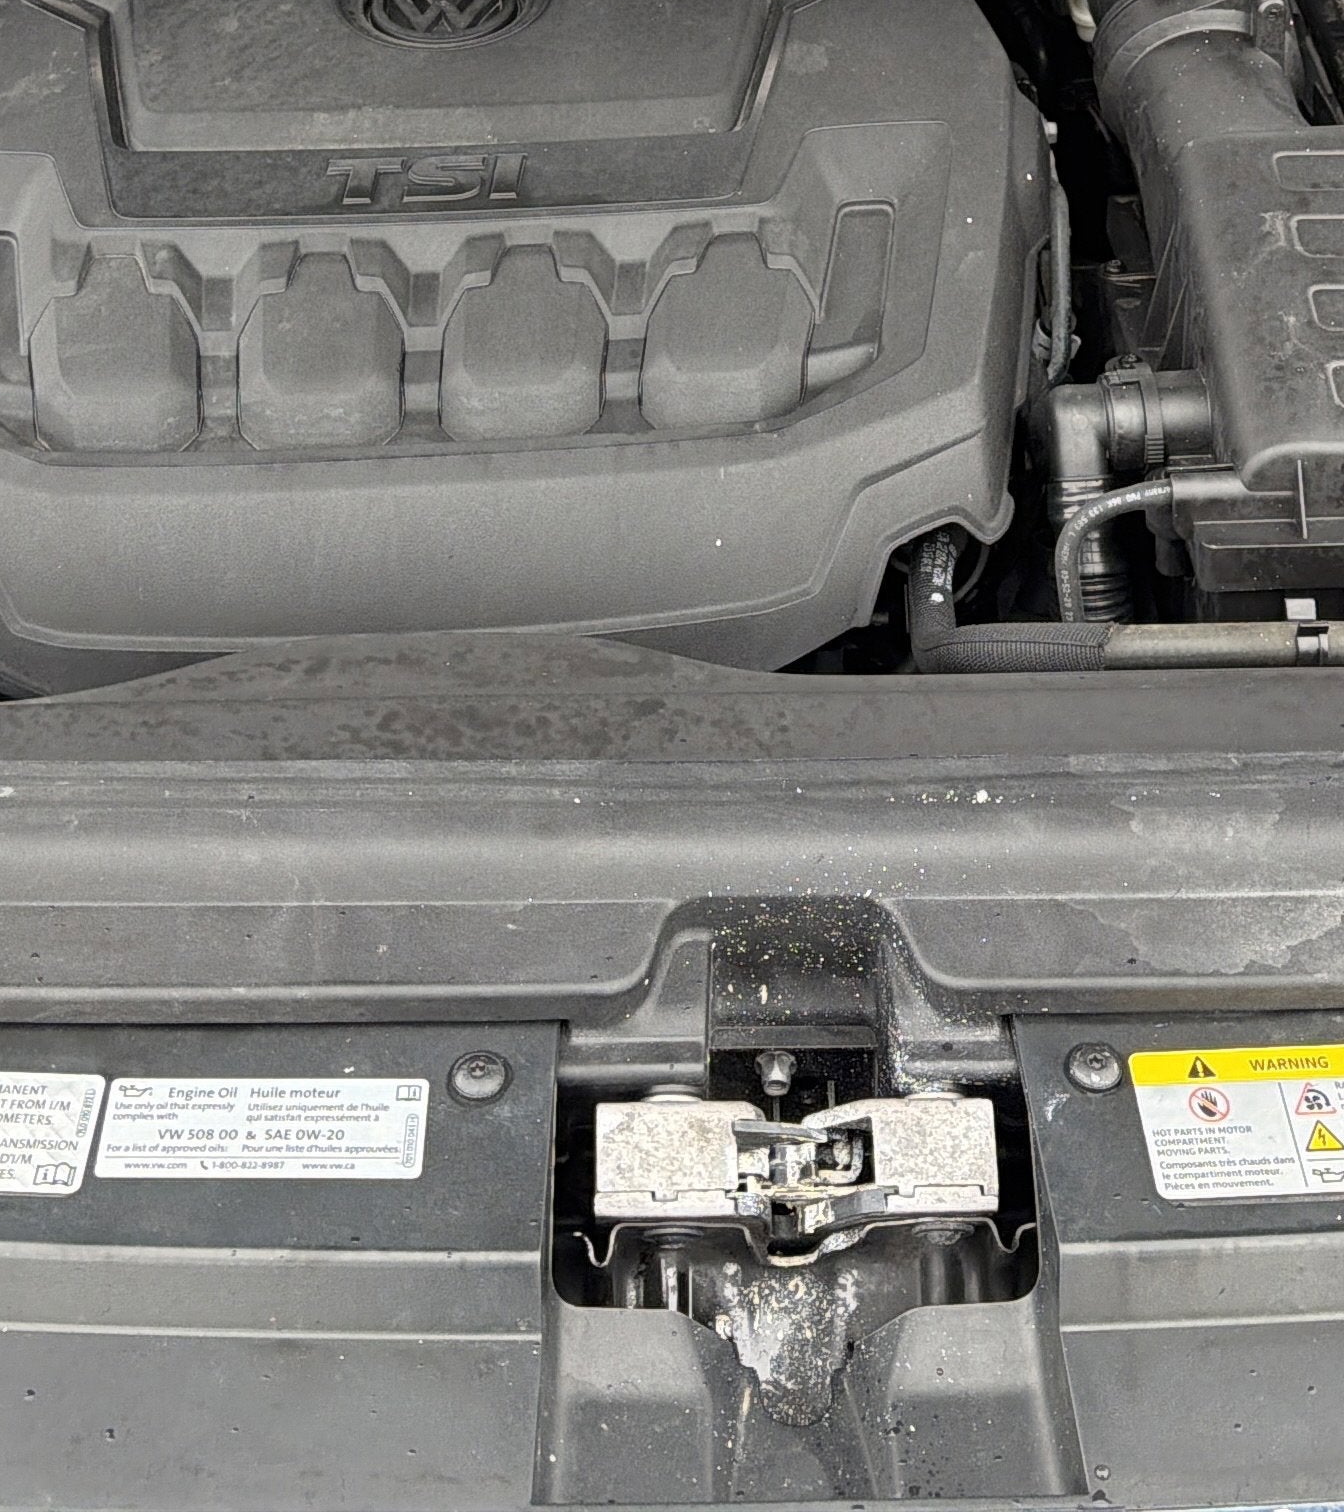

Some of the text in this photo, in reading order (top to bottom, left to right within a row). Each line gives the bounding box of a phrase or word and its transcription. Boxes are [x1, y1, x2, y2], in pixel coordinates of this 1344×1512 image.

[325, 152, 529, 205] TSI
[1249, 1056, 1329, 1072] WARNING
[167, 1087, 238, 1101] Engine Oil
[249, 1087, 340, 1098] Huile moteur
[8, 1099, 46, 1109] FROM
[48, 1100, 71, 1111] I/M
[114, 1102, 235, 1112] Use only oil that expressly
[247, 1103, 390, 1113] Utilisez uniquement de l'huile
[112, 1113, 154, 1122] complies
[245, 1113, 379, 1123] qui satisfait expressément à
[157, 1129, 345, 1140] VW 508 00 & SAE 0W-20
[1151, 1125, 1252, 1137] HOT PARTS IN MOTOR
[106, 1143, 122, 1152] For
[131, 1143, 147, 1152] list
[147, 1143, 160, 1152] of
[160, 1143, 207, 1154] approved
[241, 1144, 264, 1152] Pour
[284, 1144, 305, 1153] liste
[305, 1144, 342, 1152] d'huiles
[1156, 1146, 1230, 1156] MOVING PARTS.
[1159, 1156, 1295, 1170] Composants très chauds dans
[1161, 1168, 1283, 1180] le compartiment moteur.
[1163, 1181, 1195, 1190] Pièces
[1211, 1178, 1274, 1188] mouvement.
